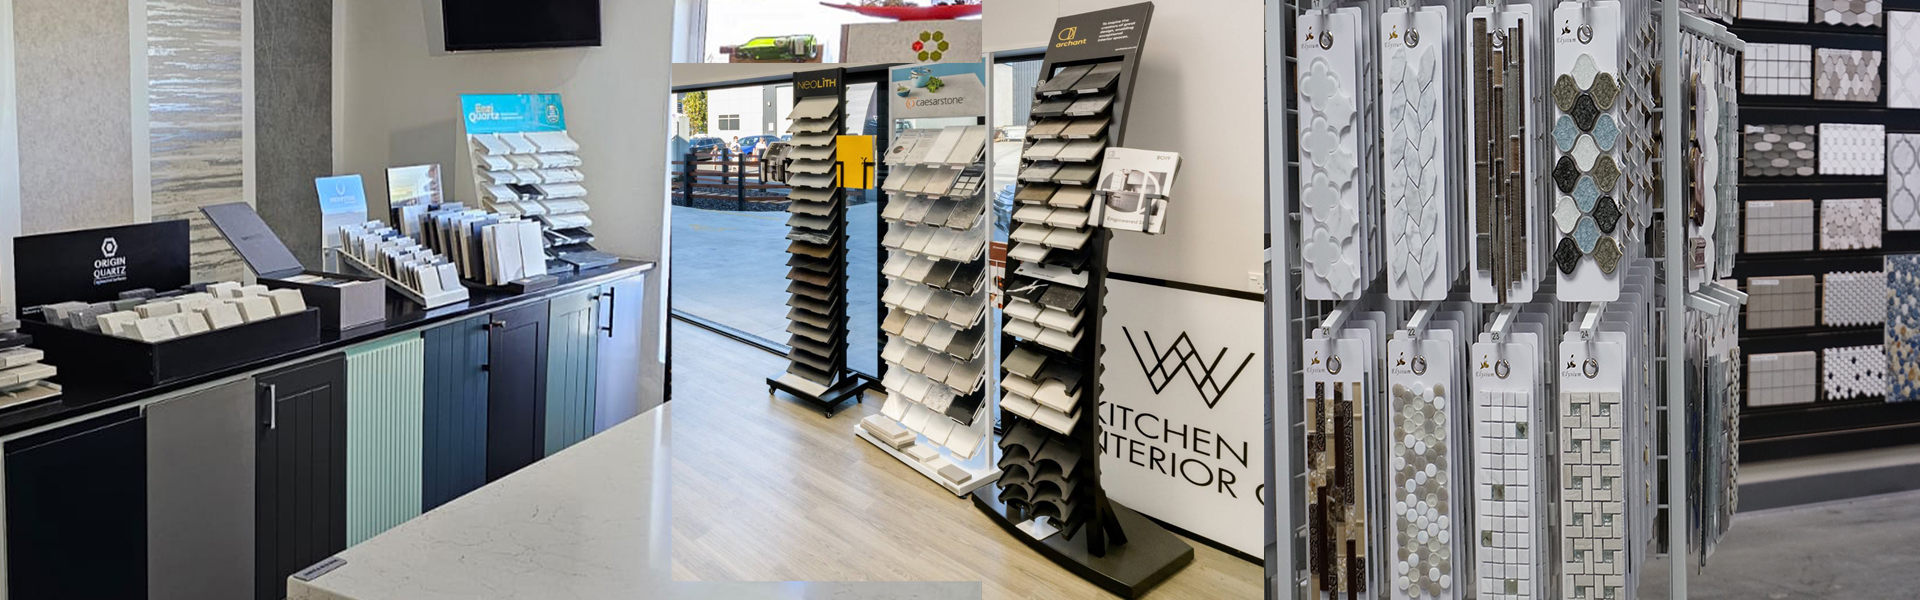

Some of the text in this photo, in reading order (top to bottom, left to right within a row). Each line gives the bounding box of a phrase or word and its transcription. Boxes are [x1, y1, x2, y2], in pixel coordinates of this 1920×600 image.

[1055, 38, 1087, 48] archant
[1556, 36, 1576, 45] Elysium
[1301, 41, 1319, 50] Elysium
[916, 96, 964, 107] caesarstone
[468, 112, 500, 123] Quartz
[1106, 216, 1138, 225] Engineered
[94, 256, 126, 269] ORIGIN
[93, 266, 126, 279] QUARTZ
[1322, 327, 1330, 335] 21
[1408, 328, 1416, 336] 22
[1581, 330, 1589, 338] 24
[1491, 332, 1500, 340] 23
[1306, 367, 1325, 375] Elysium
[1391, 368, 1411, 376] Elysium
[1475, 370, 1494, 379] Elysium
[1561, 370, 1582, 379] Elysium
[1099, 430, 1238, 499] NTERIOR
